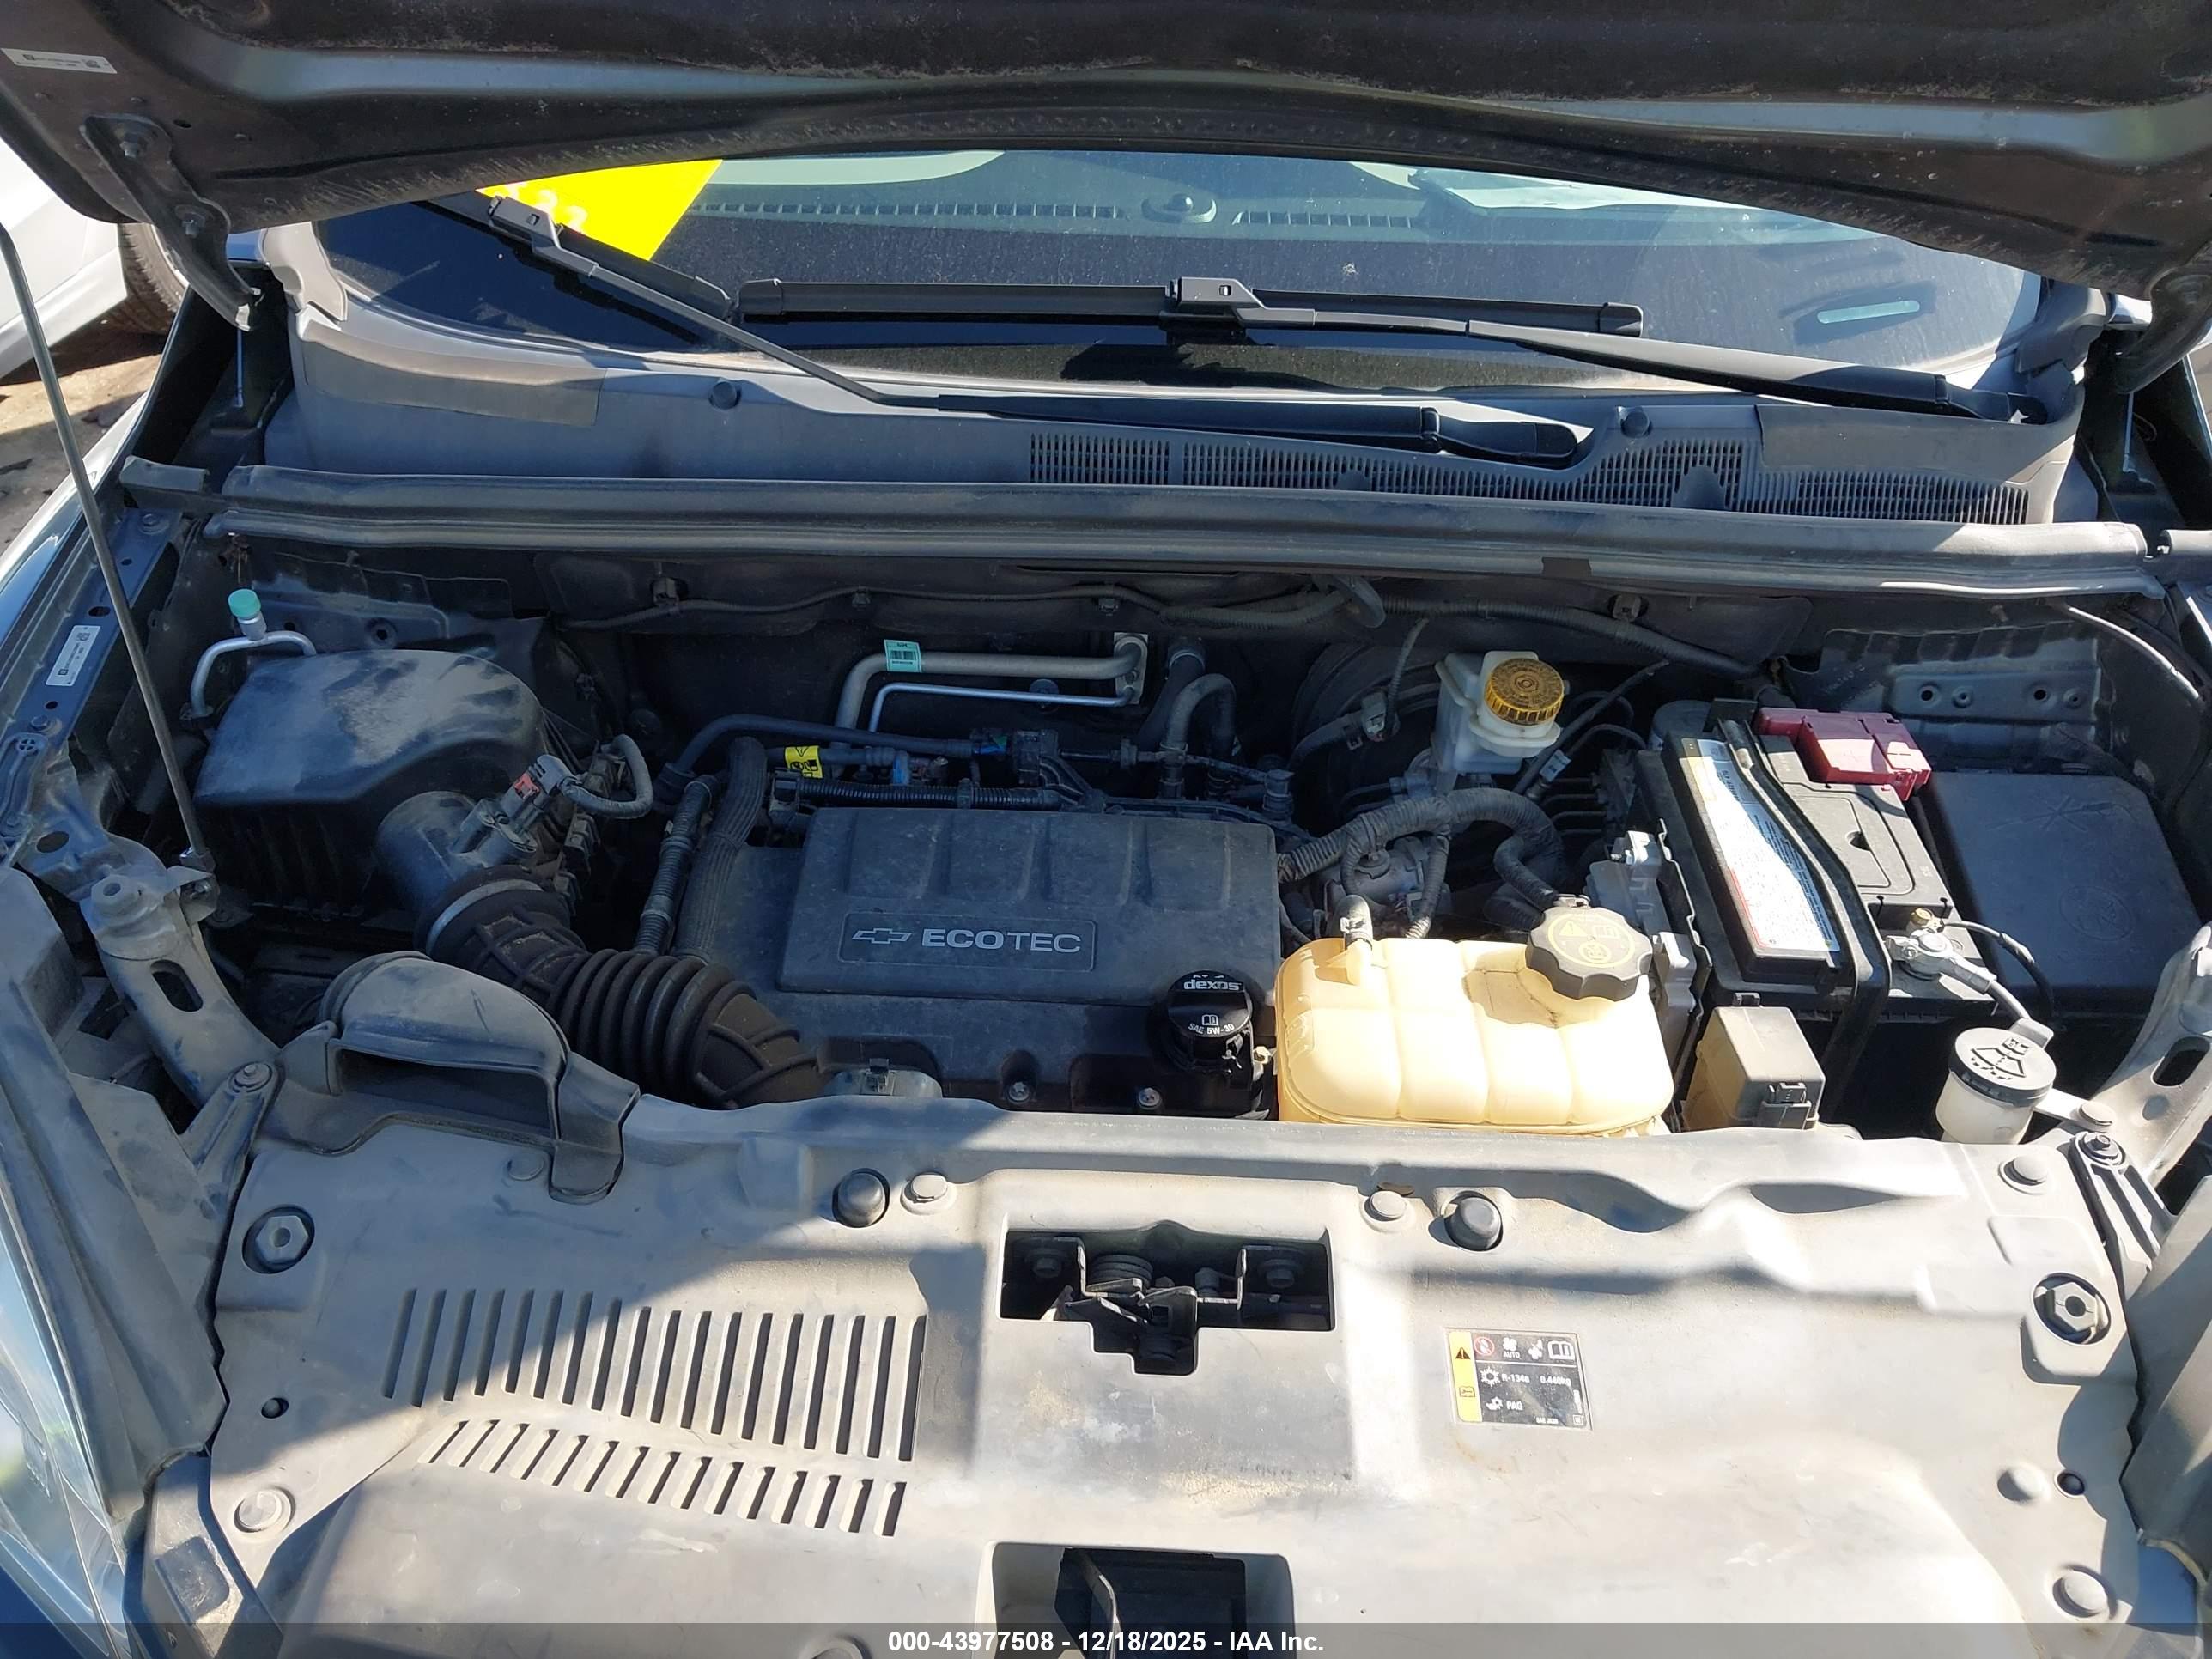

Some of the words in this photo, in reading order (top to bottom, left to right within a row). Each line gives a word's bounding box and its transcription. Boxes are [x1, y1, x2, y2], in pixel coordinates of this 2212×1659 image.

[921, 928, 1082, 953] ECOTEC
[1183, 979, 1242, 991] dexos
[1188, 1023, 1205, 1035] SAE
[1206, 1023, 1236, 1036] 5W-30
[1503, 1351, 1521, 1359] AUTO
[1501, 1374, 1530, 1383] R-134a
